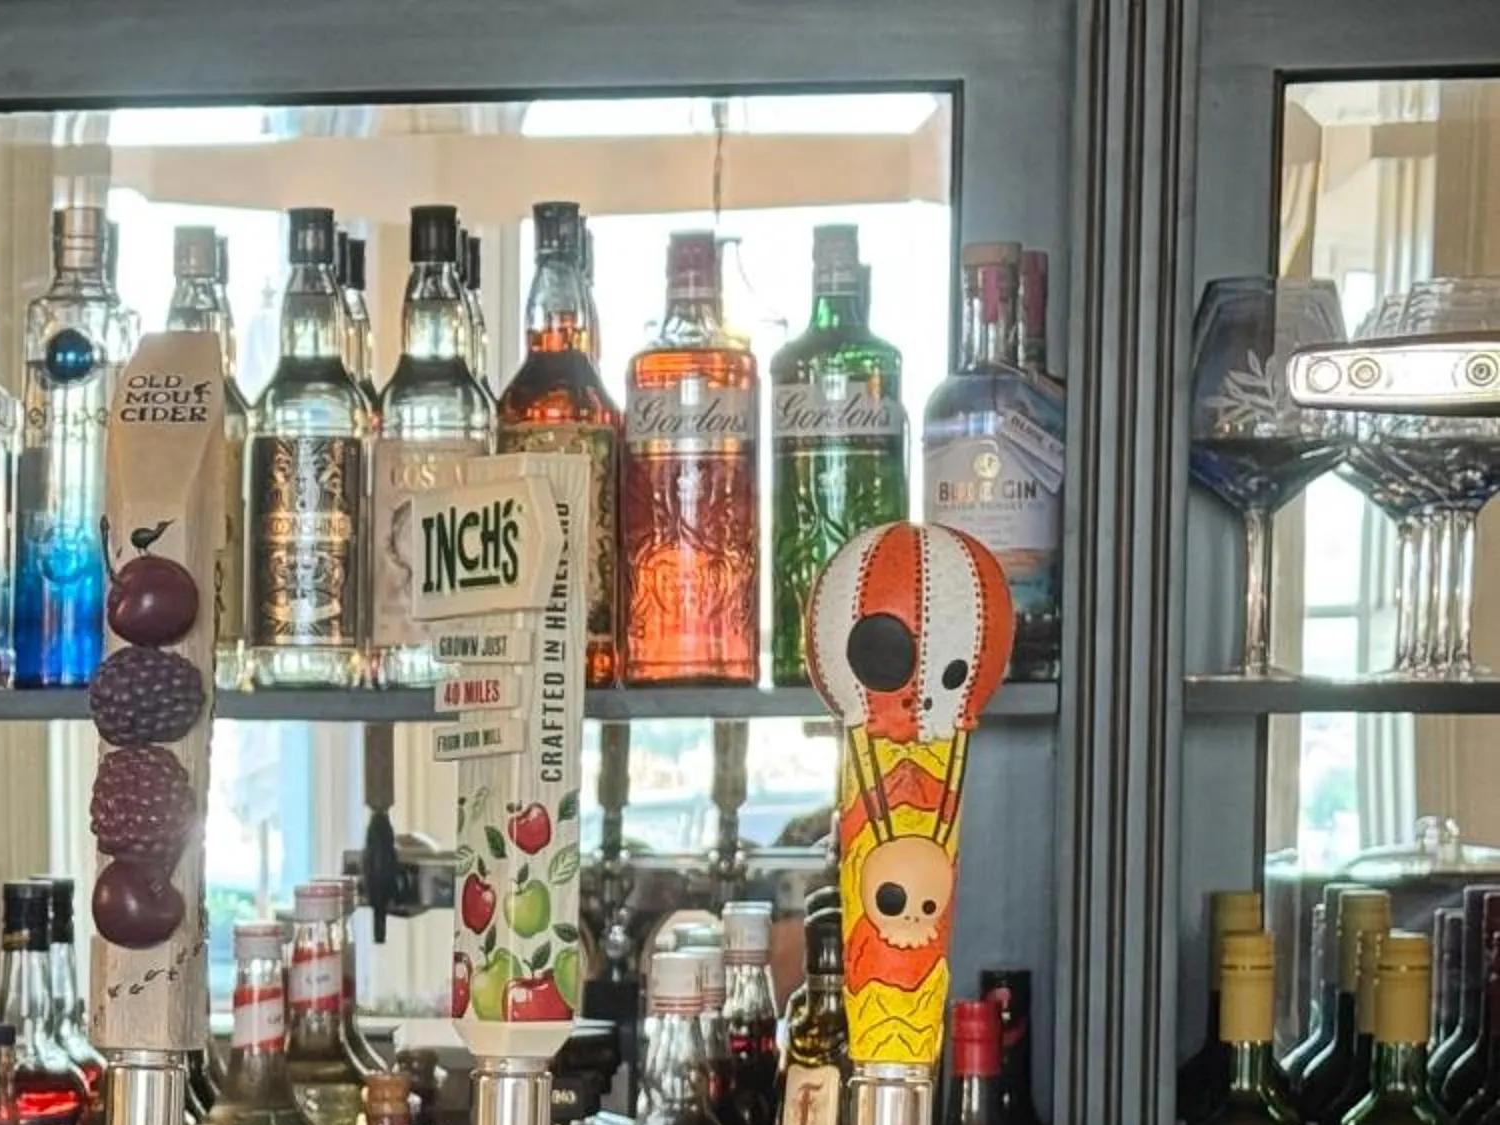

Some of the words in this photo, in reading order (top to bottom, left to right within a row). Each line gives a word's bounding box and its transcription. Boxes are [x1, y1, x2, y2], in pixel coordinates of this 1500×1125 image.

[127, 374, 183, 389] OLD
[125, 389, 212, 405] MOUT
[119, 406, 208, 423] CIDER
[440, 634, 479, 657] GROWN
[481, 634, 508, 657] JUST
[544, 642, 566, 661] IN
[463, 679, 500, 705] MILES
[541, 673, 565, 783] CRAFTED
